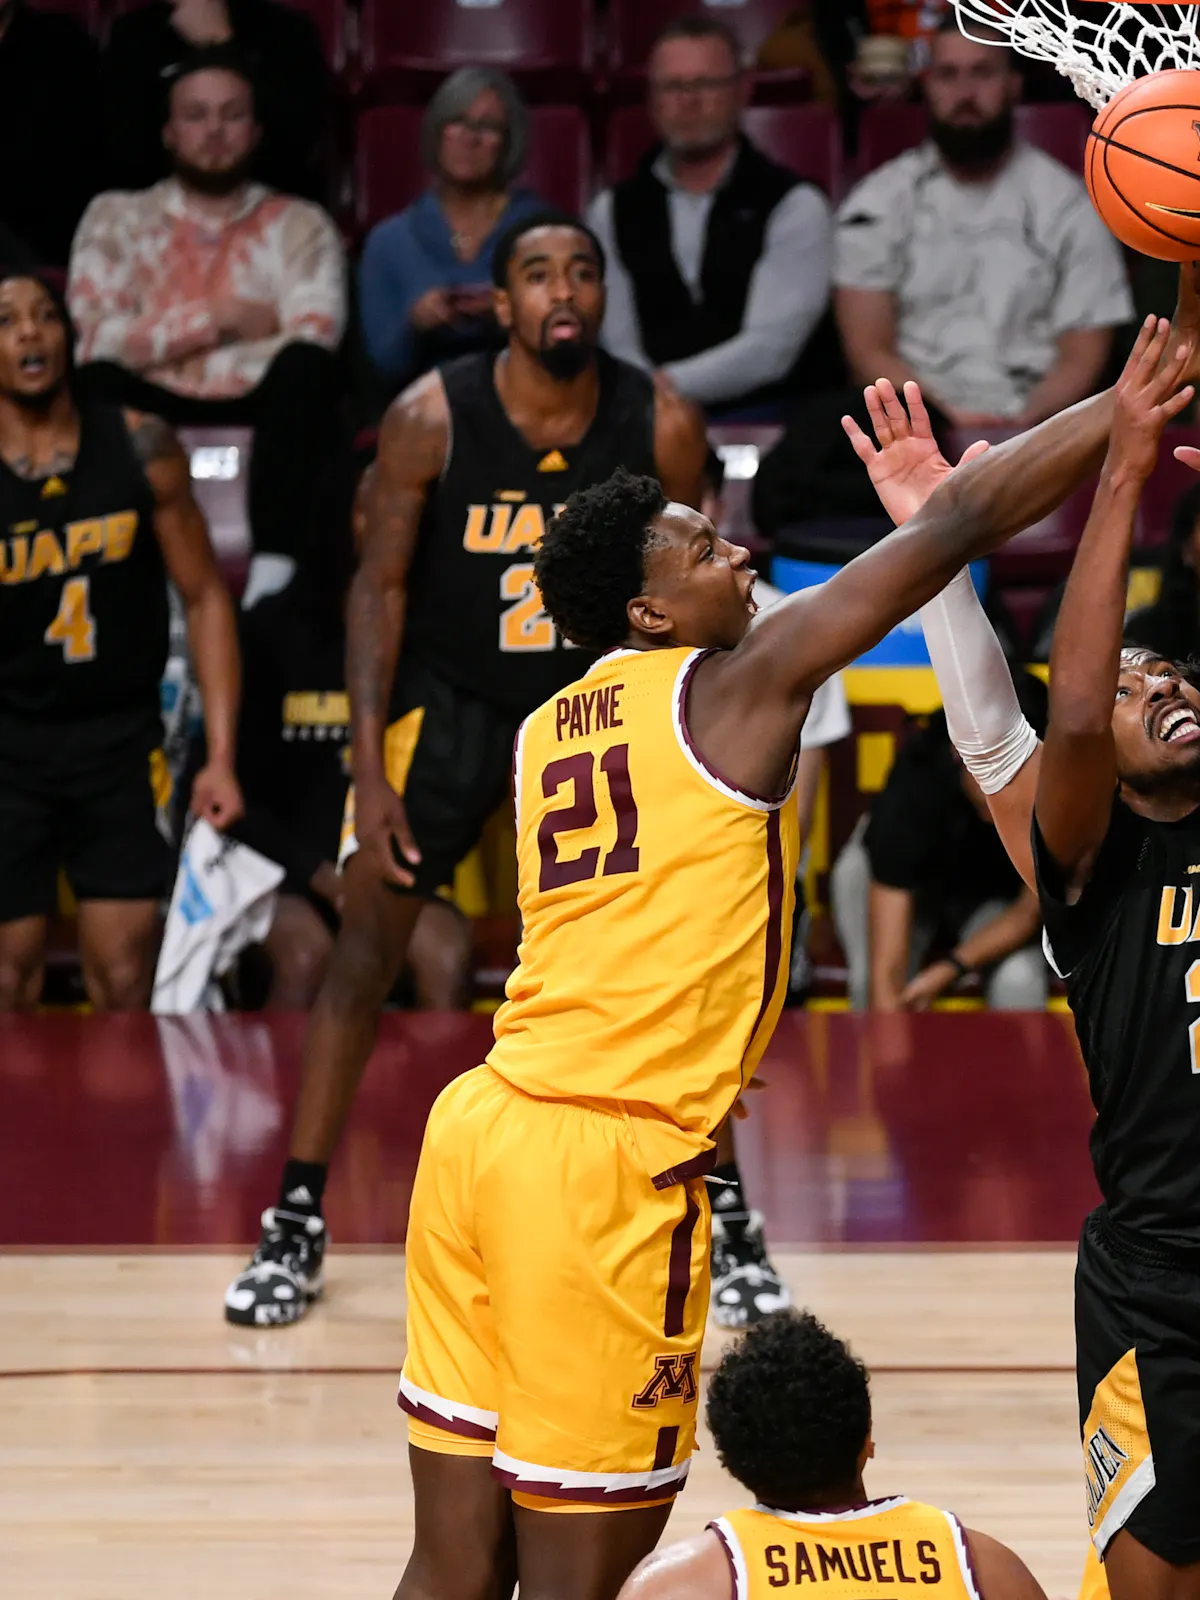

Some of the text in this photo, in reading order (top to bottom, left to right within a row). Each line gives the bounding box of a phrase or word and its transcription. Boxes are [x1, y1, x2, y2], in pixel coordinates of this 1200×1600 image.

[44, 575, 97, 664] 4
[498, 562, 582, 652] 2
[556, 684, 624, 741] PAYNE
[537, 743, 640, 893] 21
[631, 1351, 697, 1408] M
[764, 1539, 941, 1588] SAMUELS
